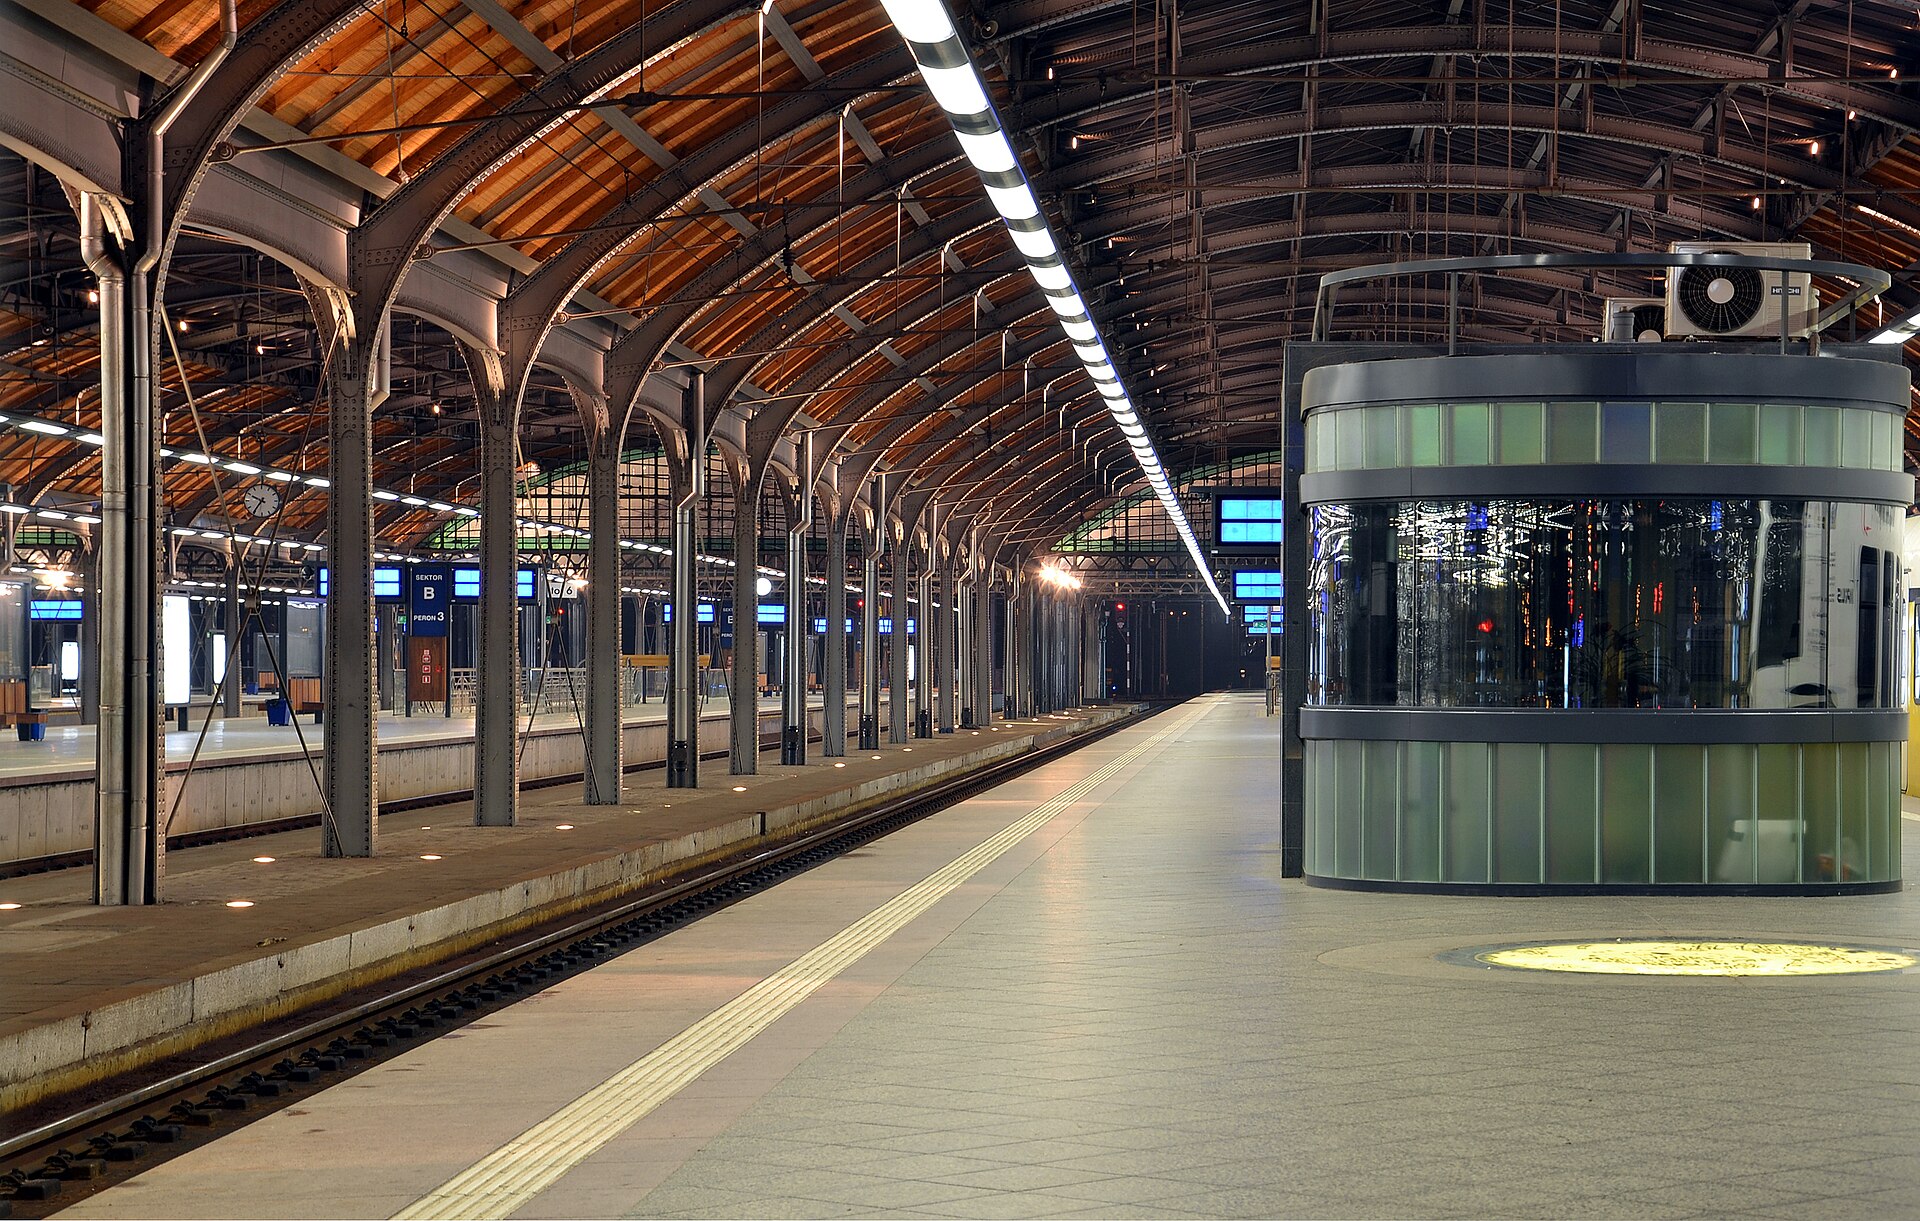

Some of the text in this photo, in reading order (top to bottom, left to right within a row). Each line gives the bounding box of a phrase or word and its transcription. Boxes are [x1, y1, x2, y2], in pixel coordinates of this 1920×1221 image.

[423, 586, 435, 600] B
[566, 585, 573, 595] 6
[437, 611, 445, 621] 3
